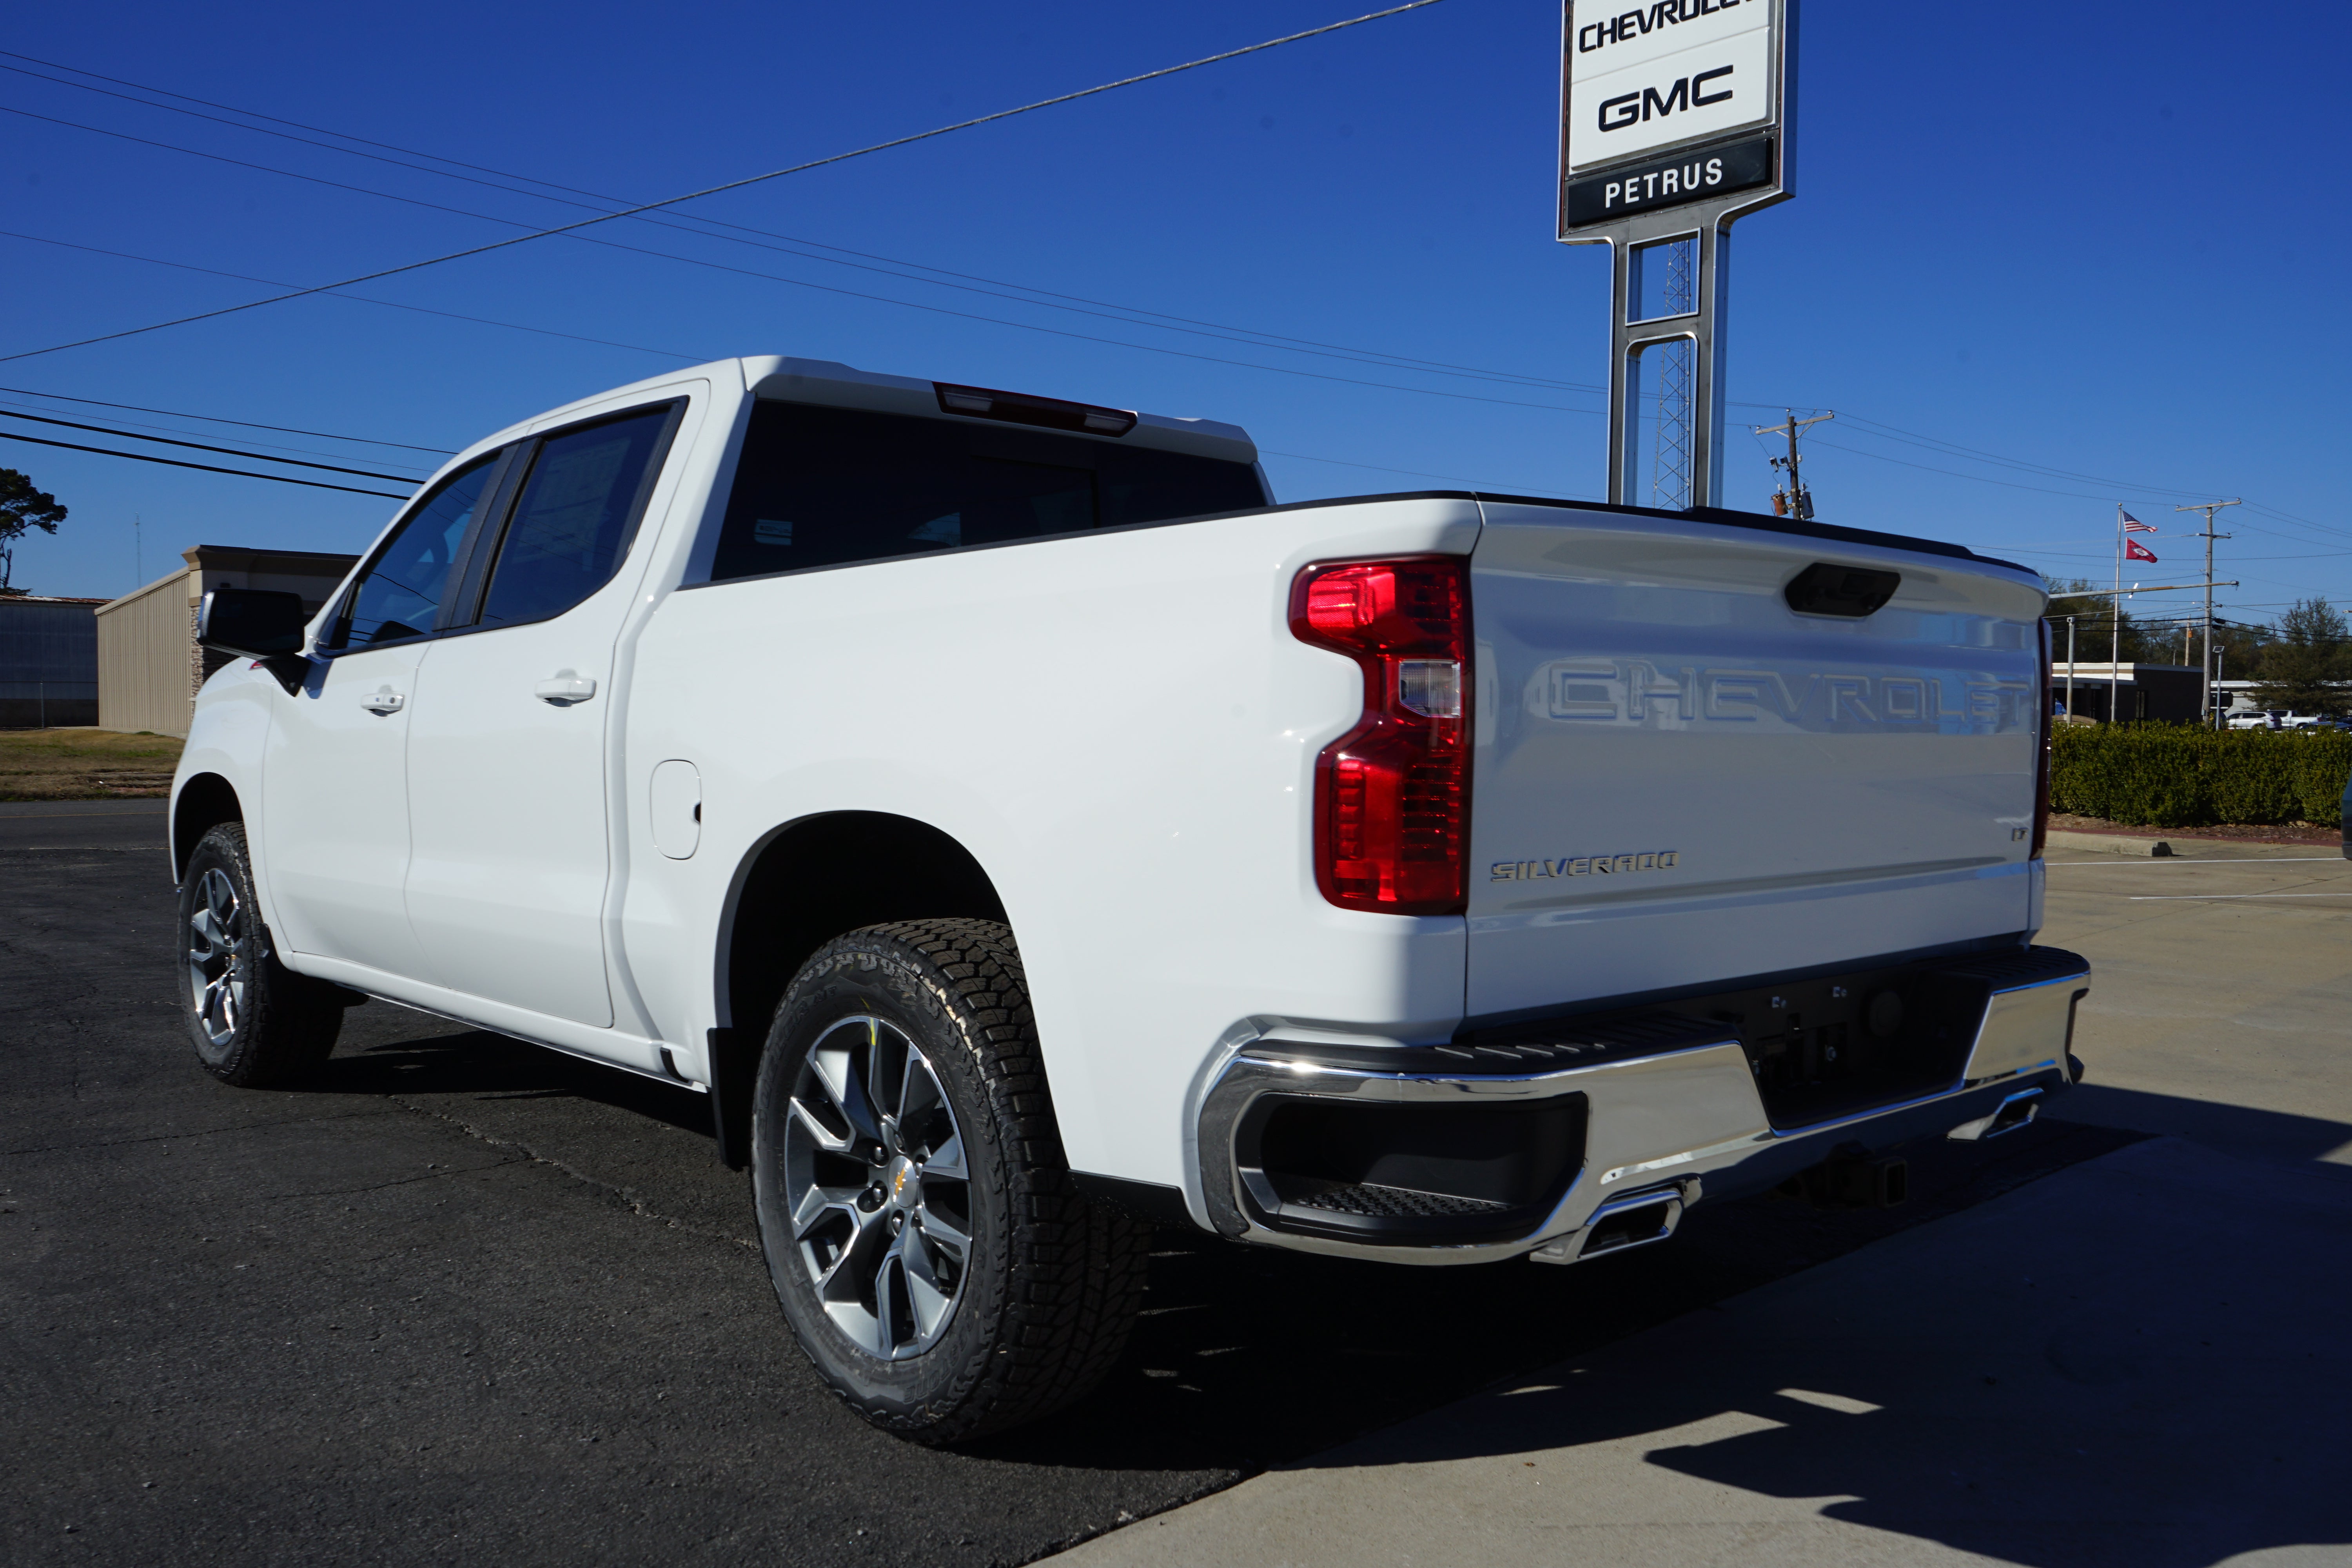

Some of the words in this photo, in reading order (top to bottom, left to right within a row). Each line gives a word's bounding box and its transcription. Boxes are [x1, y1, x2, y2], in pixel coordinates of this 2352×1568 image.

[1579, 0, 1753, 53] CHEVROL
[1599, 64, 1733, 132] GMC
[1605, 158, 1722, 208] PETRUS
[1549, 663, 2030, 724] CHEVROLET
[2012, 828, 2029, 841] LT
[1491, 851, 1679, 882] SILVERADO
